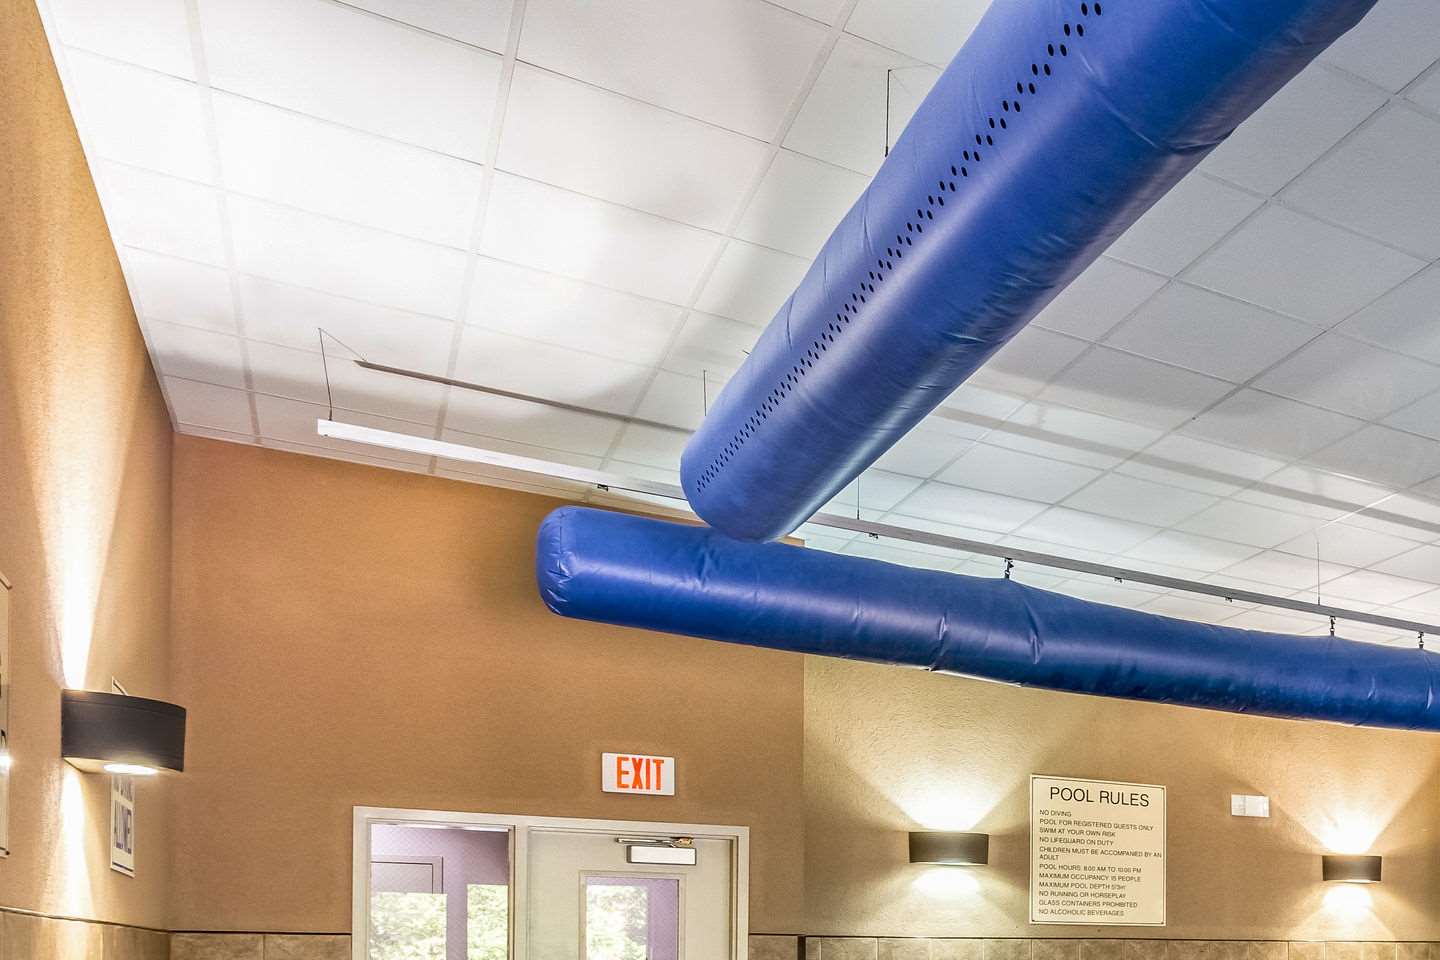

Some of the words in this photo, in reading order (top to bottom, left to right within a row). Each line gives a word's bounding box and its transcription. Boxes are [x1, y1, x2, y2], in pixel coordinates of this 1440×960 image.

[617, 756, 664, 790] EXIT
[1050, 786, 1095, 802] POOL
[1100, 790, 1149, 807] RULES
[1067, 828, 1084, 836] YOUR
[1074, 820, 1112, 829] REGISTERED
